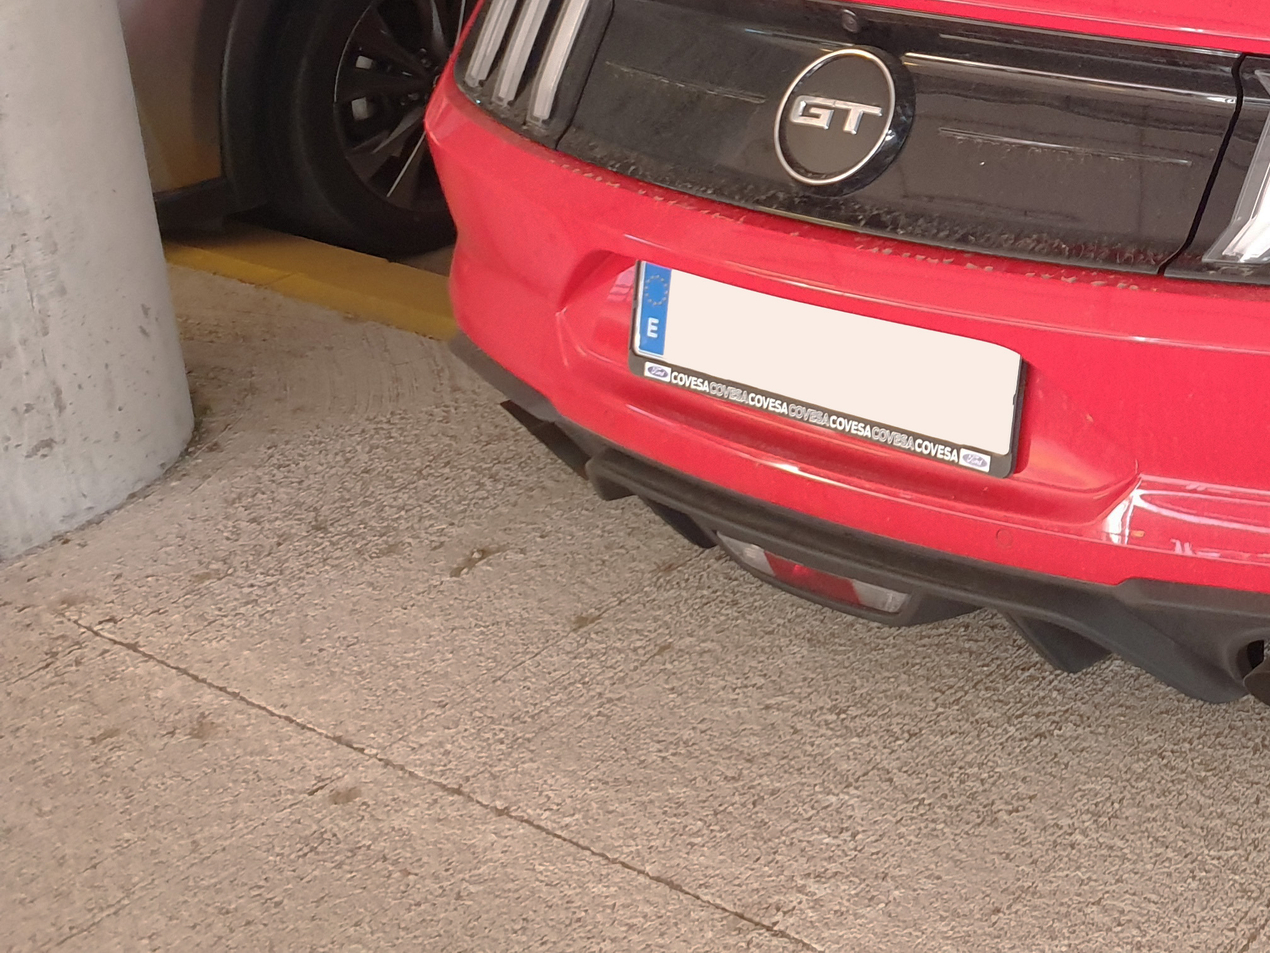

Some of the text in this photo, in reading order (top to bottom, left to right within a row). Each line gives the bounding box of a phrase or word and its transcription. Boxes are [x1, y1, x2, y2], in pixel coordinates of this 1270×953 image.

[789, 94, 883, 135] GT
[647, 317, 660, 339] E
[671, 371, 710, 393] COVESA
[748, 393, 789, 416] COVESA
[829, 415, 872, 438] COVESA
[914, 438, 959, 463] COVESA
